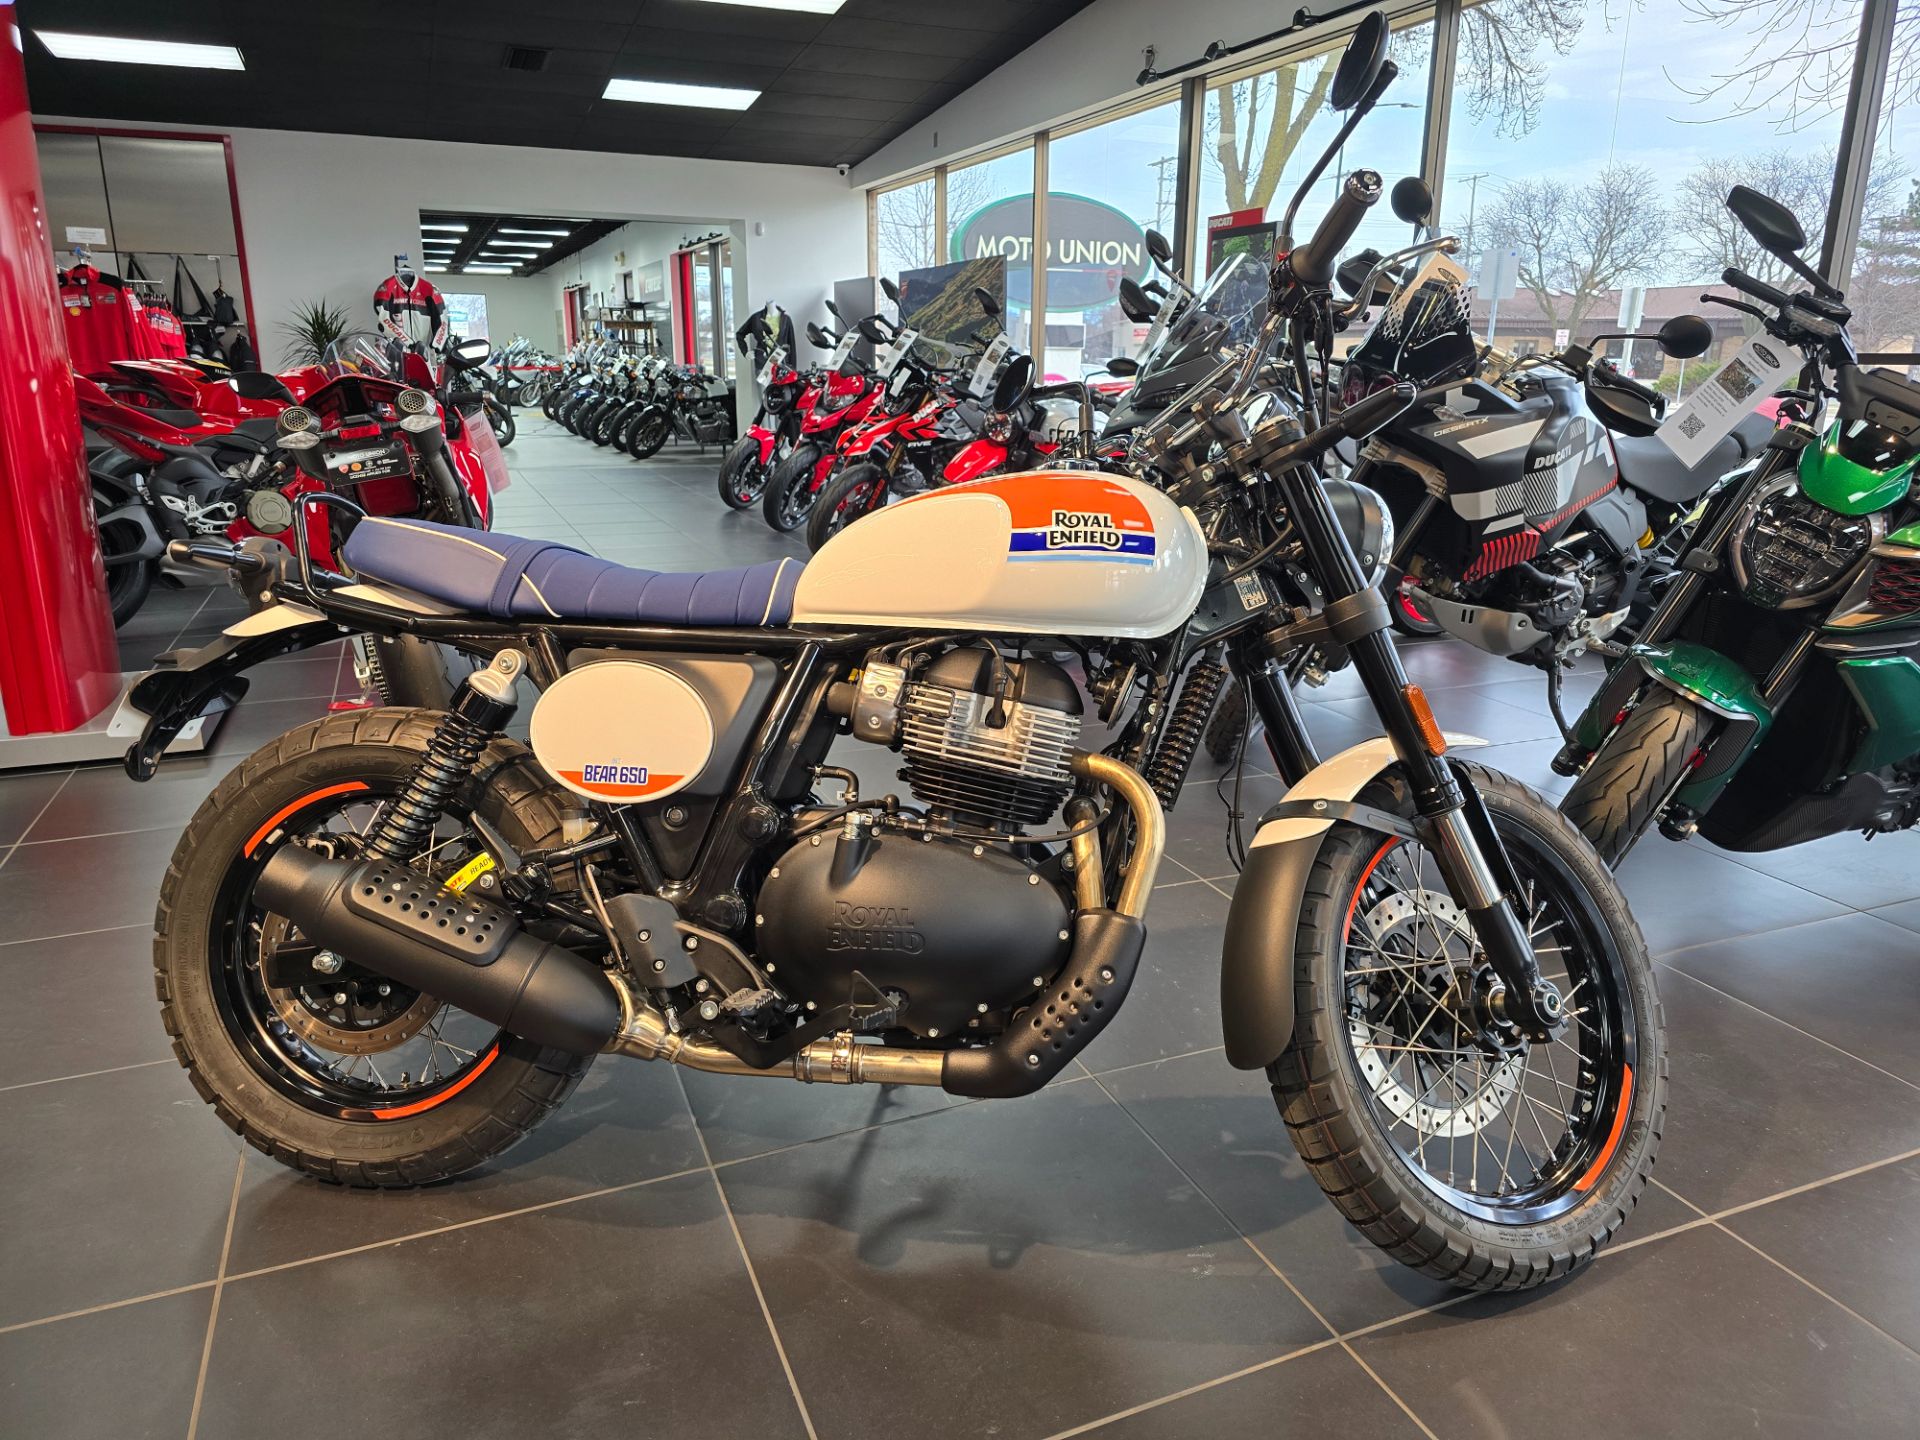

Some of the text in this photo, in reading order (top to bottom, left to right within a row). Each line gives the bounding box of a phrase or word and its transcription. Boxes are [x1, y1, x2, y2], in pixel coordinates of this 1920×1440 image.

[1209, 216, 1233, 228] DUCATI
[975, 235, 1141, 266] MOT UNION
[383, 318, 408, 342] DUCATI
[435, 321, 447, 345] DUCATI
[1433, 416, 1489, 437] DESERTX
[1533, 444, 1572, 470] DUCATI
[1054, 511, 1113, 529] ROYAL
[1049, 530, 1121, 548] ENFIELD
[584, 765, 648, 784] BEAR 650
[833, 900, 915, 929] ROYAL
[826, 927, 926, 955] ENFIELD
